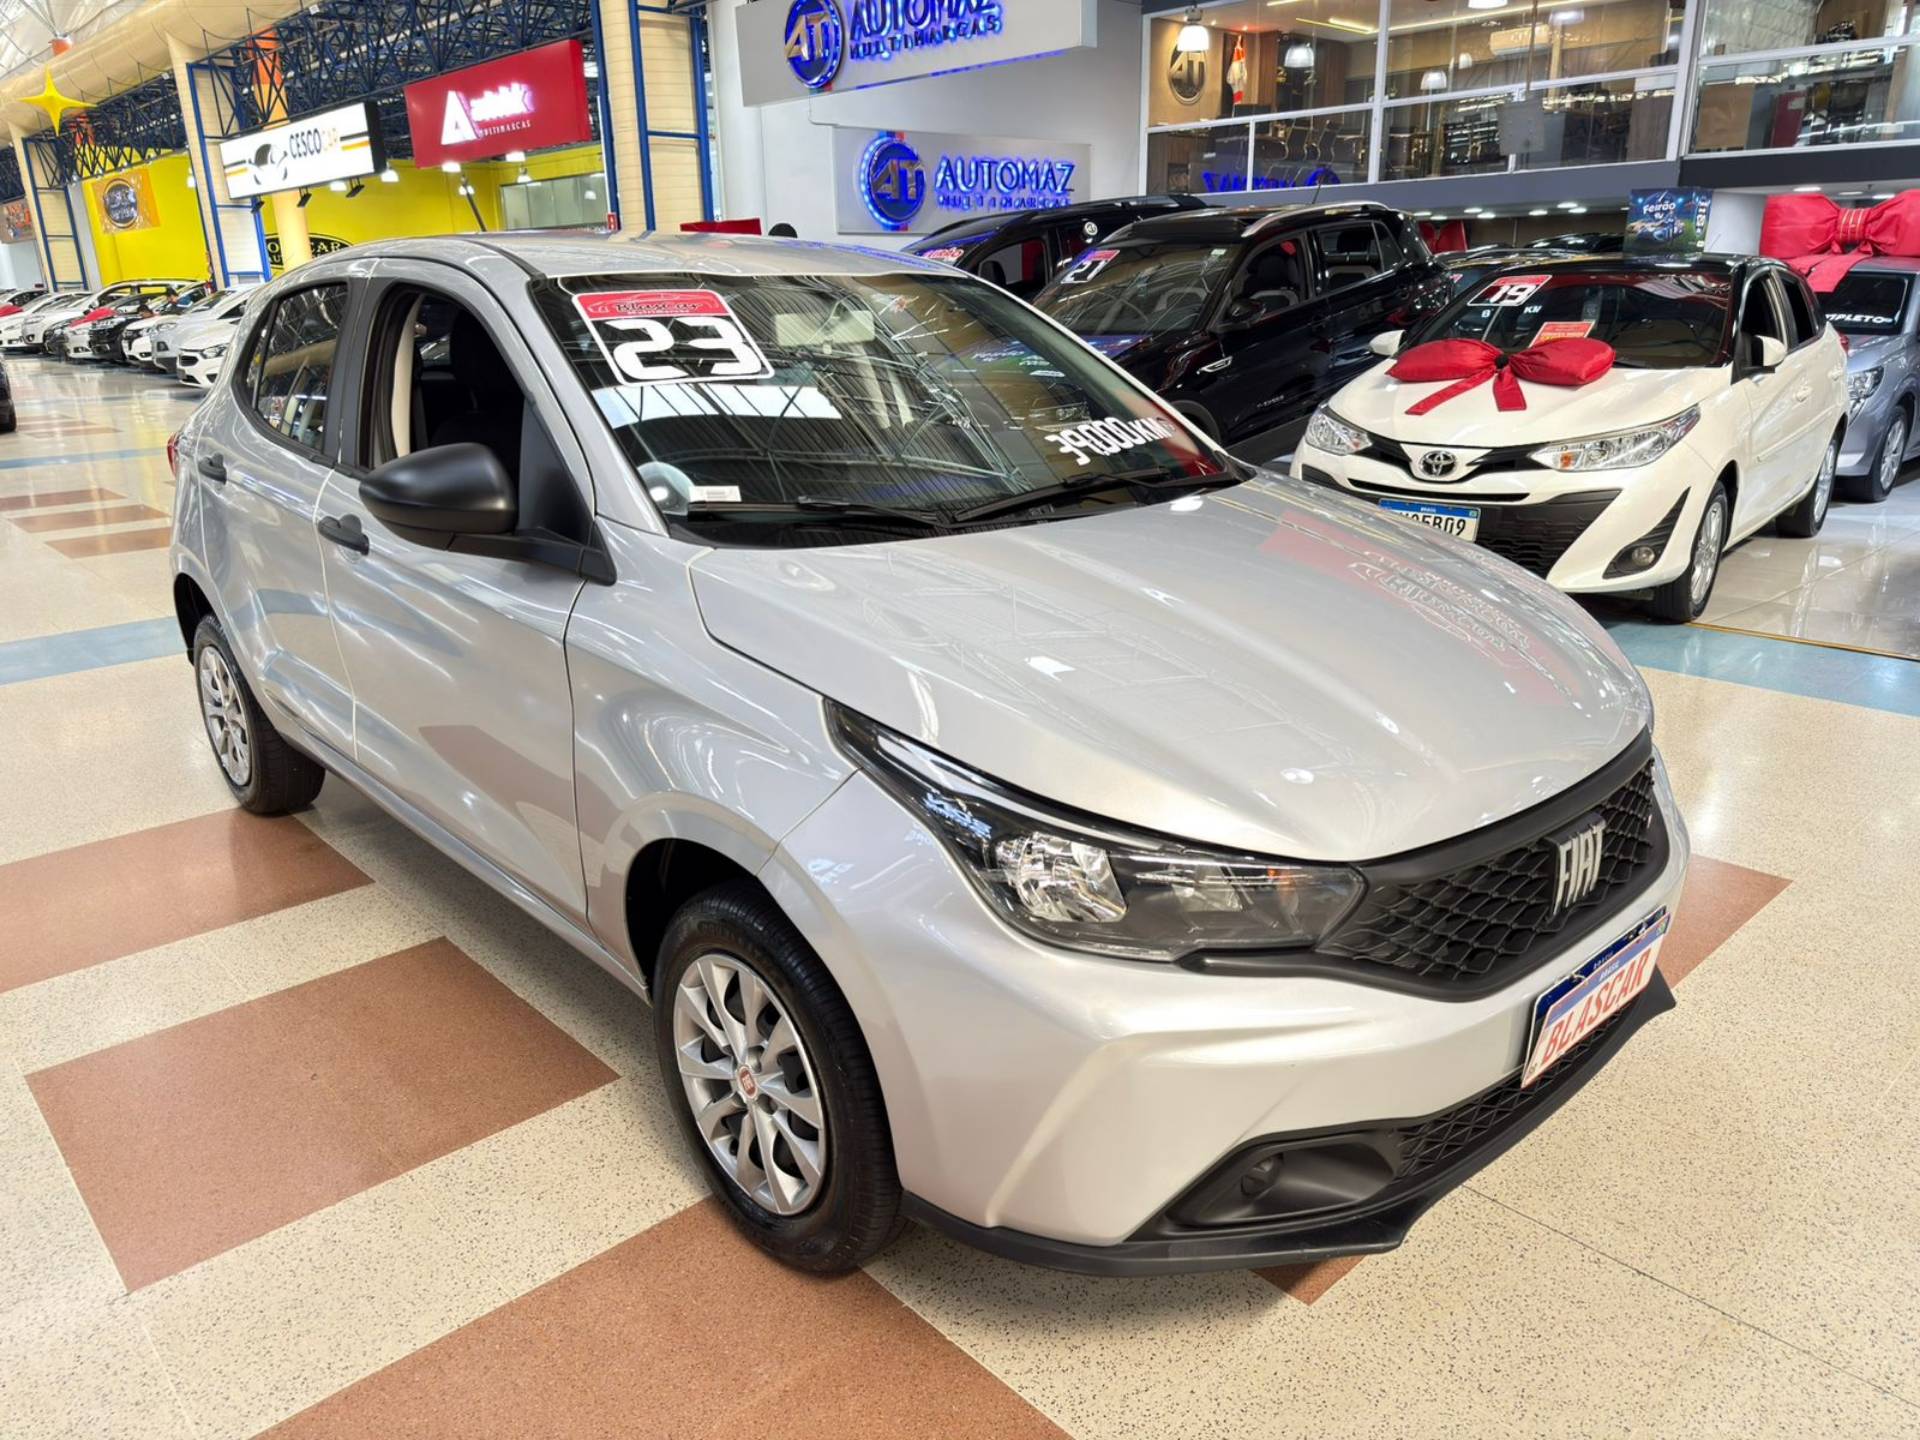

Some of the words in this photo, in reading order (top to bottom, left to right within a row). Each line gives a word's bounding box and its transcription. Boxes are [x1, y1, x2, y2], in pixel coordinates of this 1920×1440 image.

[850, 14, 1000, 60] MULTIMARCAS
[935, 157, 1075, 193] AUTOMAZ
[1489, 284, 1537, 303] 19
[604, 316, 762, 380] 23
[1553, 819, 1607, 916] FIAT
[1543, 947, 1652, 1066] BLASCAR
